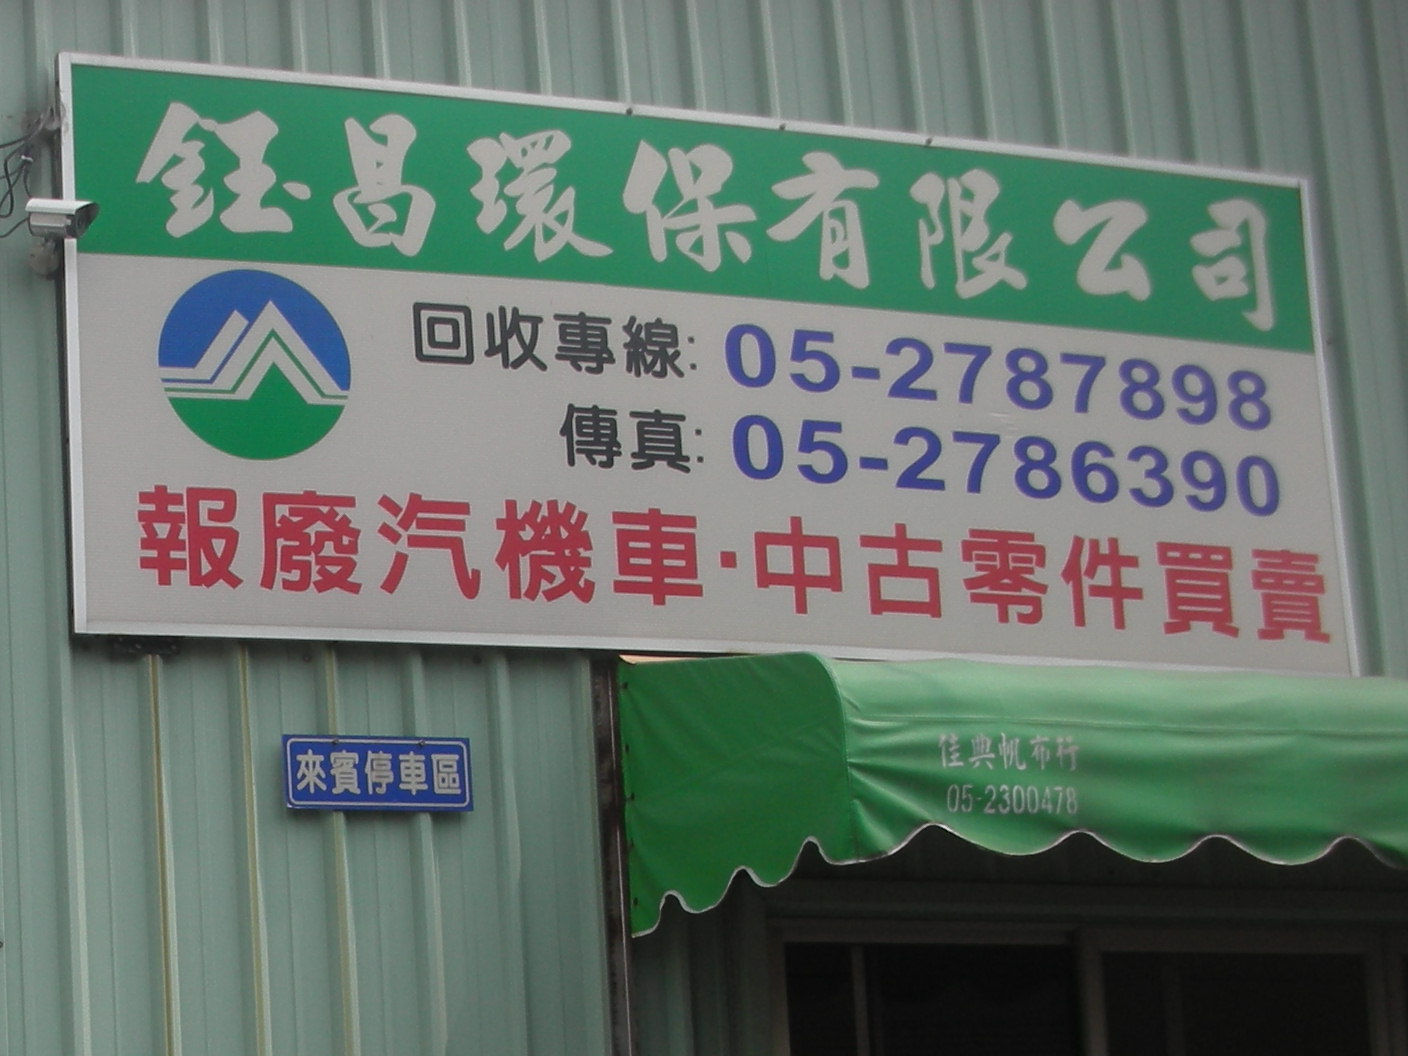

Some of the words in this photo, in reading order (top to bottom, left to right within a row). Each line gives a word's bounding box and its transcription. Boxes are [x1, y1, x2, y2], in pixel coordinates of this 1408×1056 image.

[135, 100, 1276, 331] 鈺昌環保有限公司
[723, 323, 1273, 432] 05-2787898
[731, 413, 1281, 518] 05-2786390
[295, 748, 463, 796] 來賓停車區
[946, 783, 1079, 815] 05-2300478
